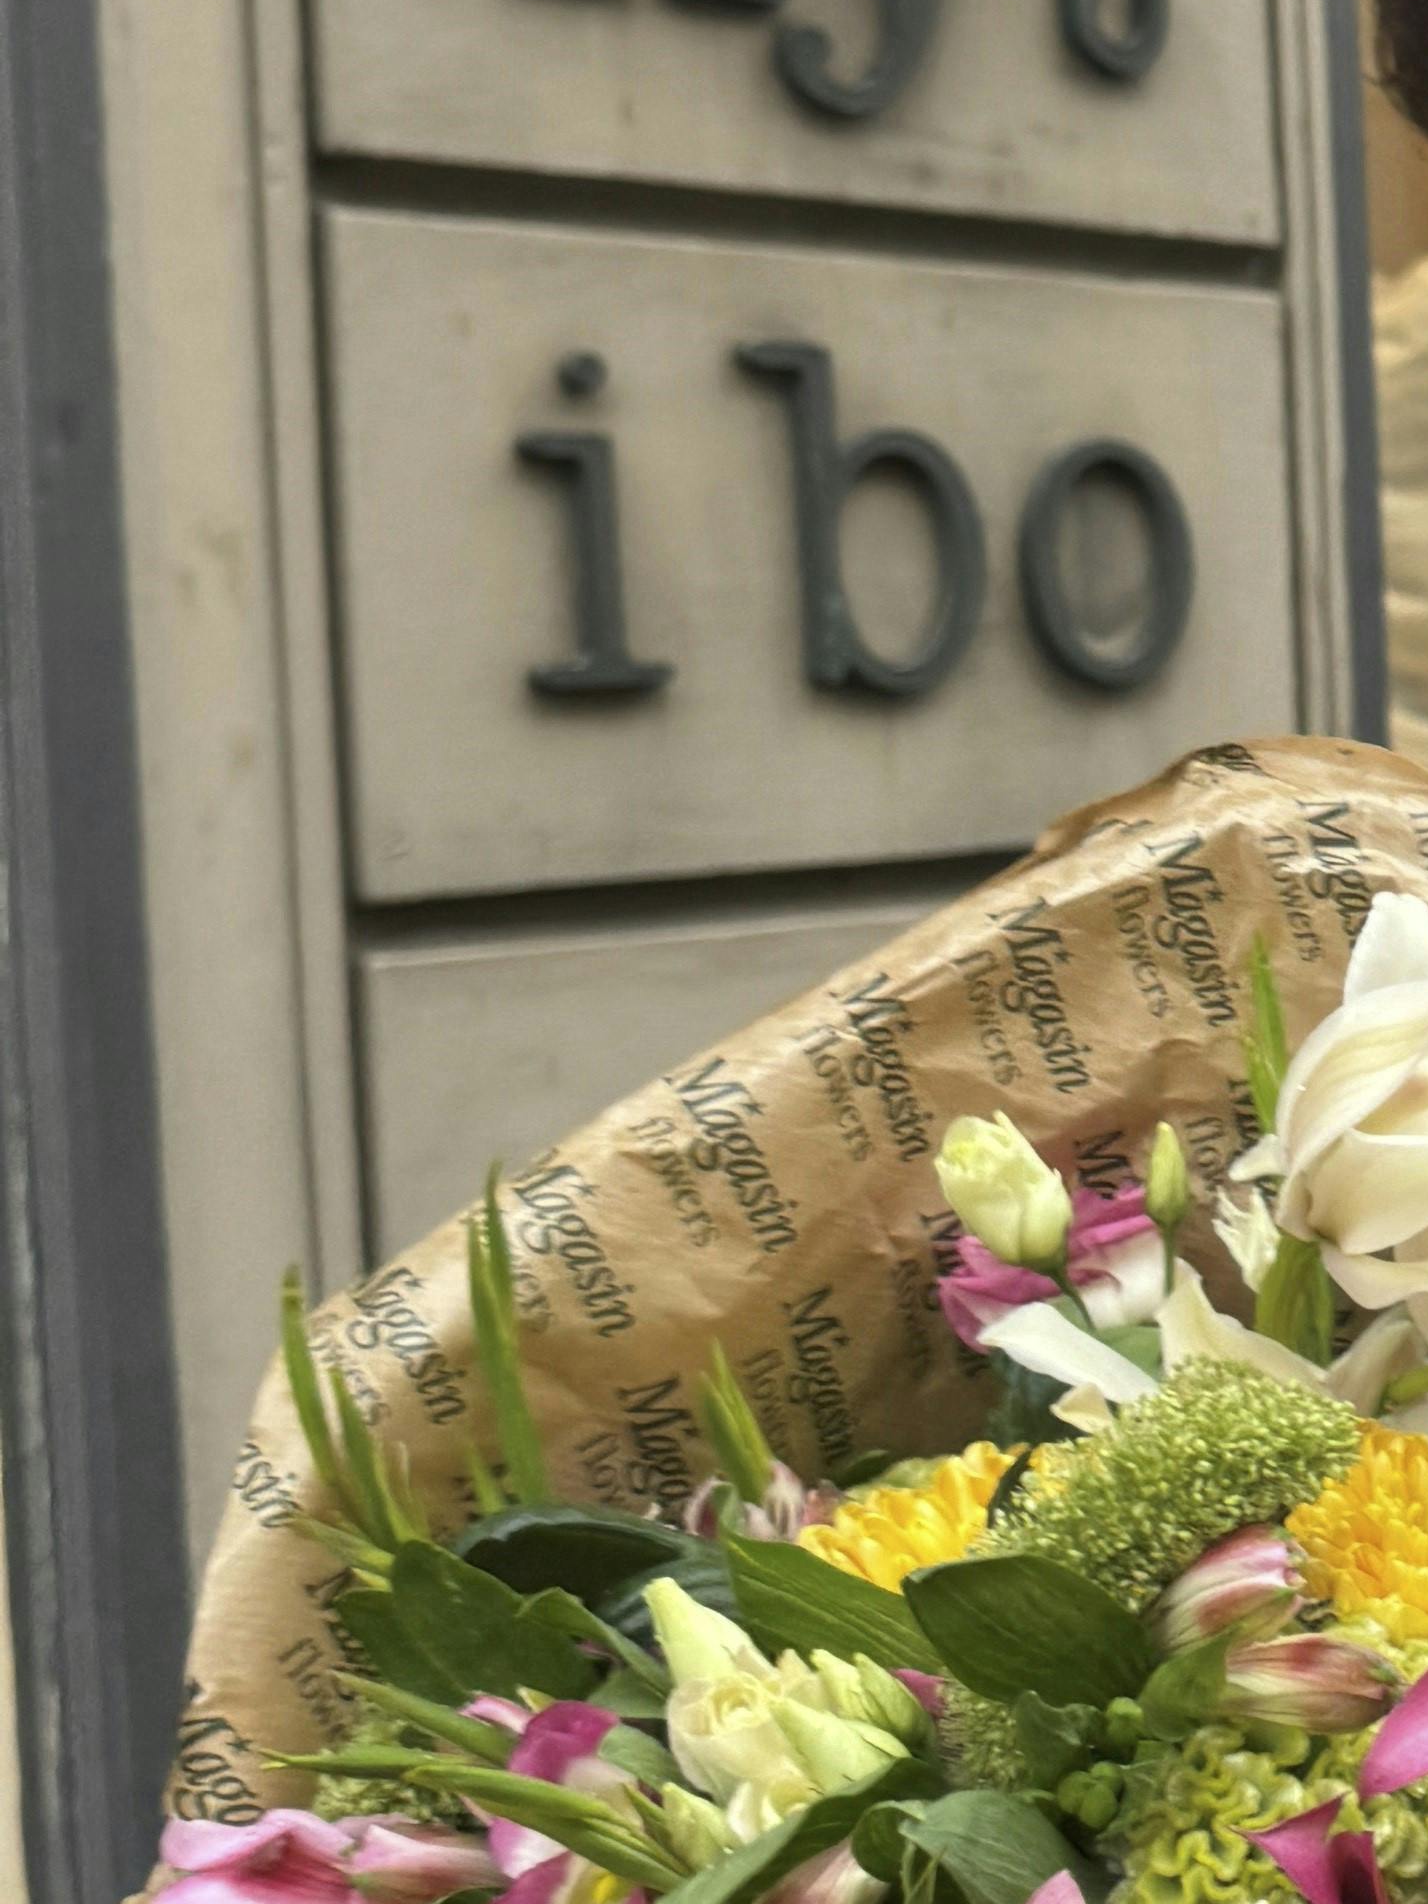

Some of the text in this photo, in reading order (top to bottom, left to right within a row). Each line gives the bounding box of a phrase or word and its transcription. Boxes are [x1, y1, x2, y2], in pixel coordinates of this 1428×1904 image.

[987, 896, 1091, 1095] Magasin
[1113, 884, 1175, 1020] flowers
[1146, 830, 1237, 1028] Magasin
[628, 1115, 720, 1248] flowers
[662, 1057, 798, 1254] Magasin
